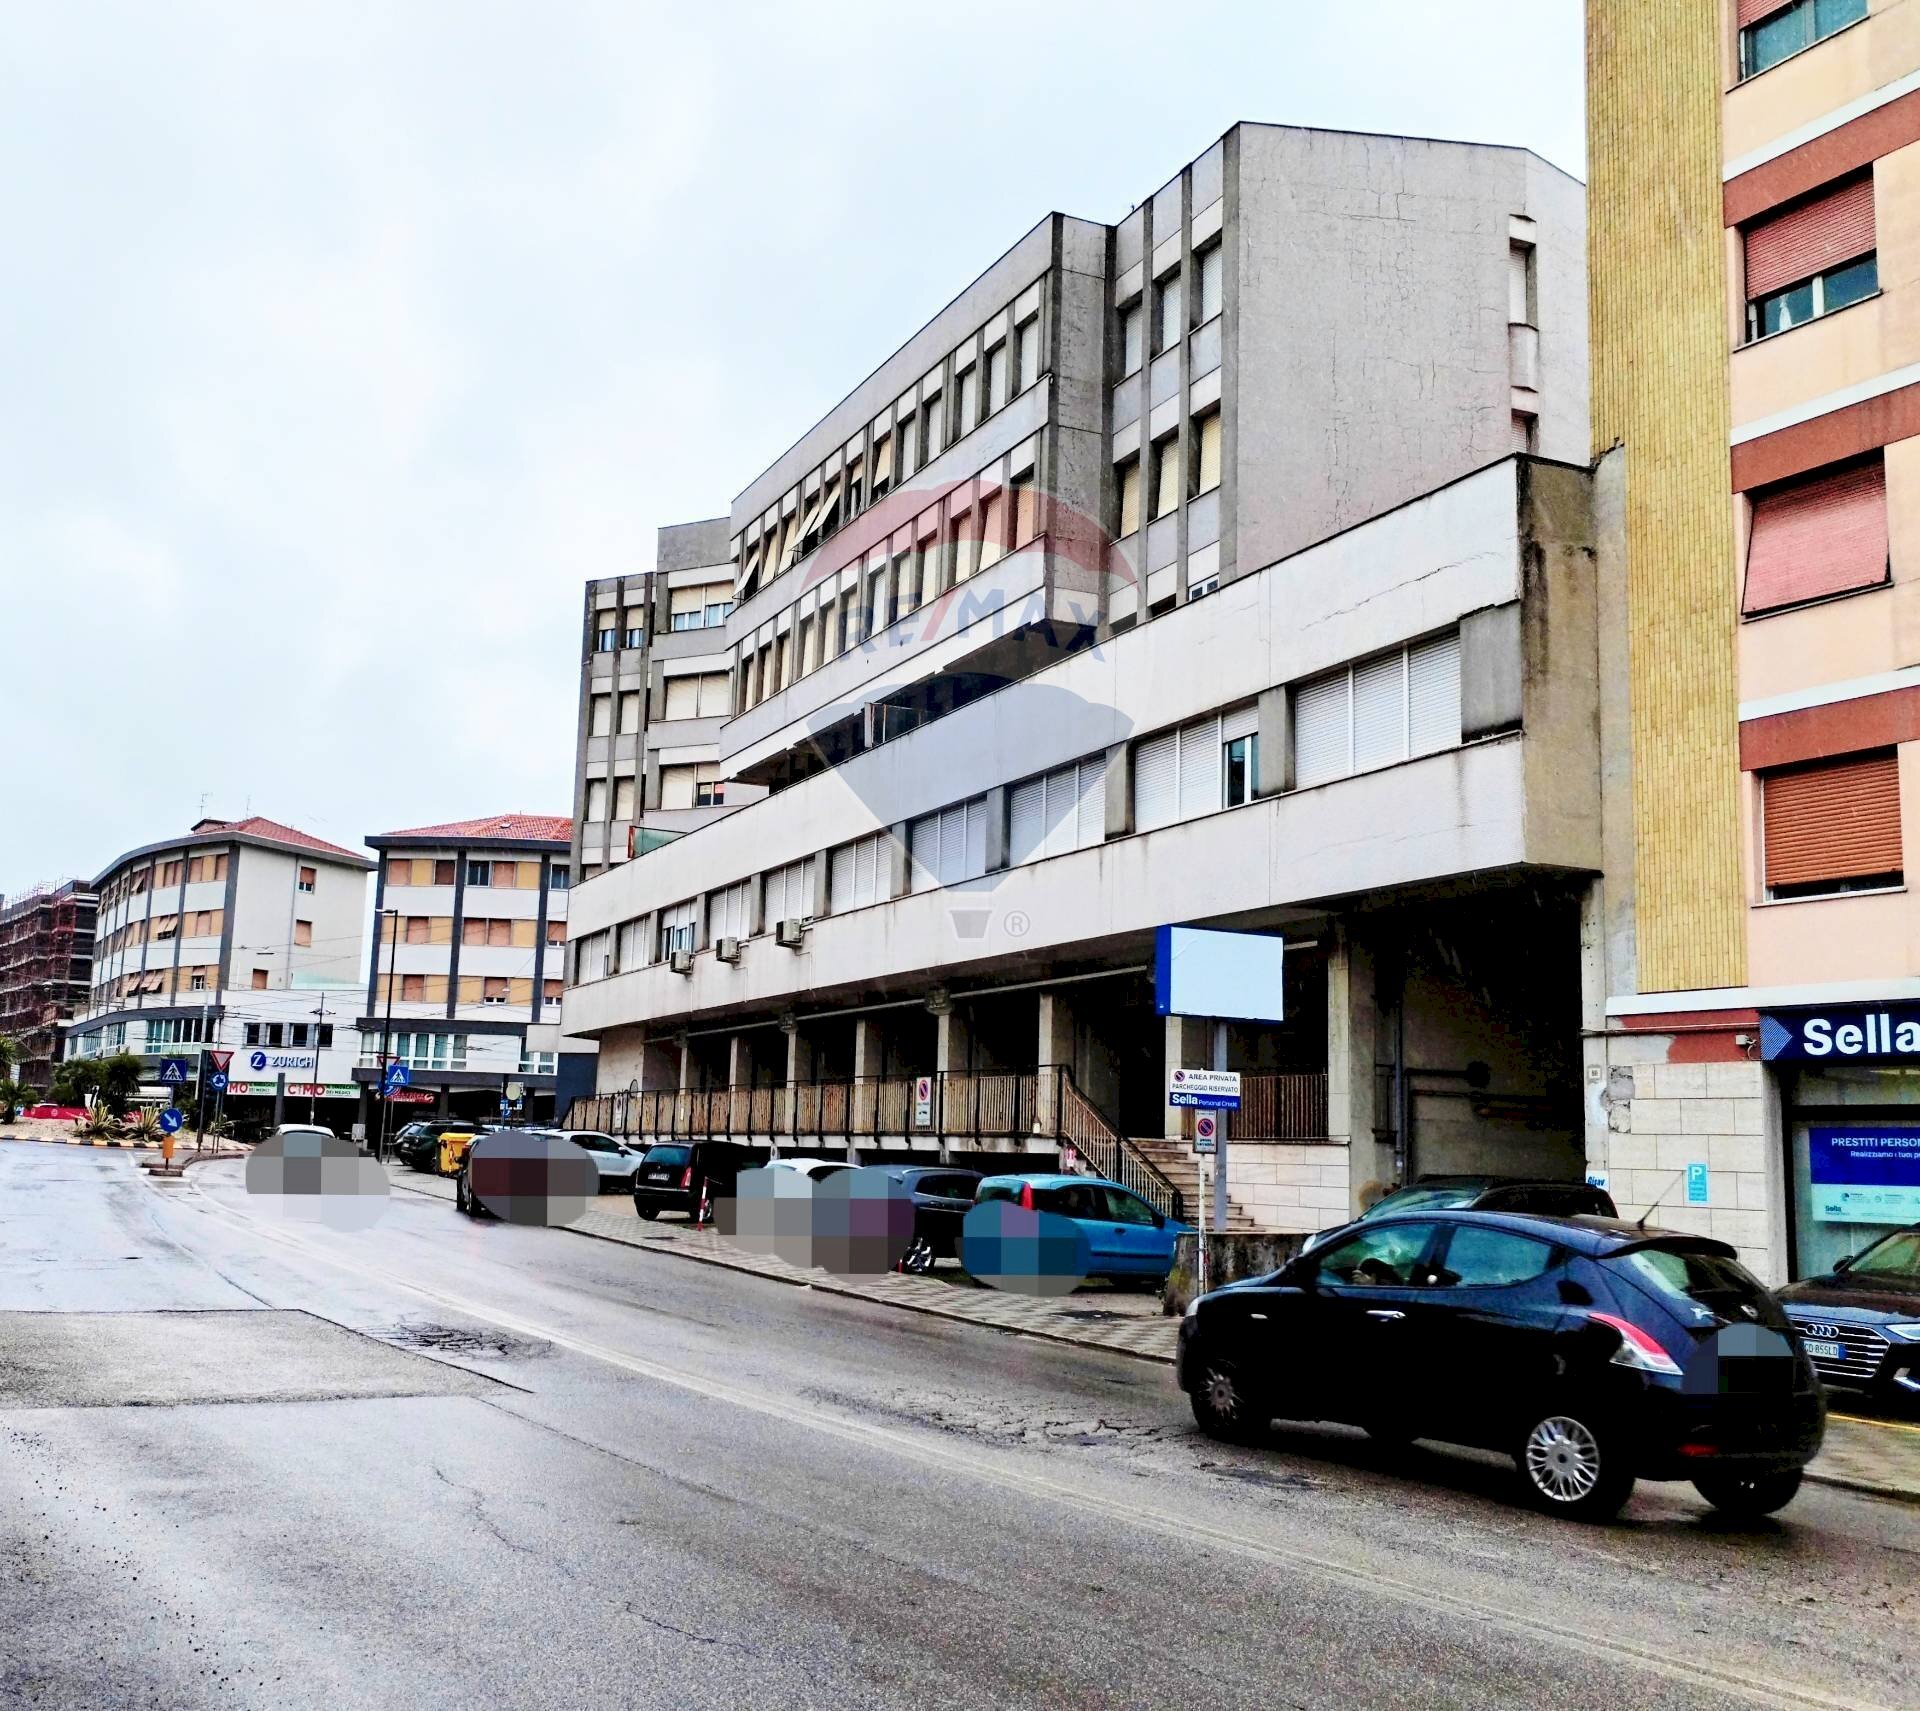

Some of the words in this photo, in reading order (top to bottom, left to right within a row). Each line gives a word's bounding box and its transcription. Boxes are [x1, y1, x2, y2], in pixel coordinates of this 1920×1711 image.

[1803, 1013, 1920, 1055] Sella
[271, 1055, 314, 1068] ZURICH
[1188, 1073, 1208, 1081] AREA
[1209, 1074, 1237, 1082] PRIVATA
[1172, 1083, 1208, 1091] PARCHEGGIO
[1209, 1085, 1239, 1093] RISERVATO
[1172, 1094, 1199, 1105] Sella
[1831, 1137, 1878, 1147] PRESTITI
[1691, 1166, 1703, 1181] P
